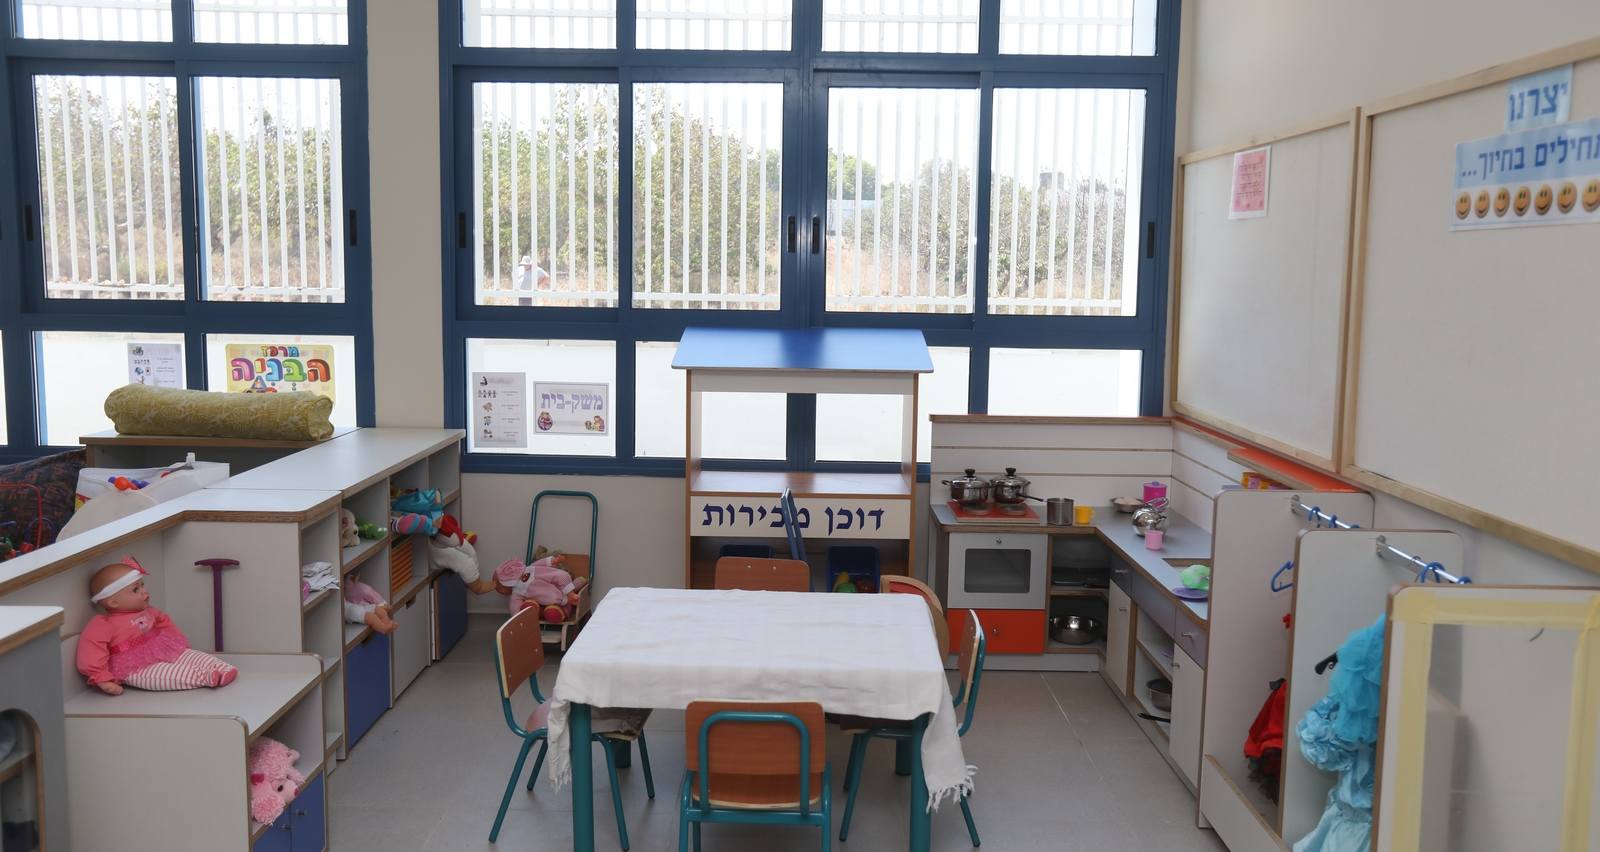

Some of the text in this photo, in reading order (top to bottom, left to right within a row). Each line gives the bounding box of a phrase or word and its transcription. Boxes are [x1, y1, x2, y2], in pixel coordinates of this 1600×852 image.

[1509, 82, 1568, 121] יצרנו
[260, 345, 300, 357] מרכז
[540, 391, 604, 414] משק-בית
[824, 506, 885, 536] דוכן
